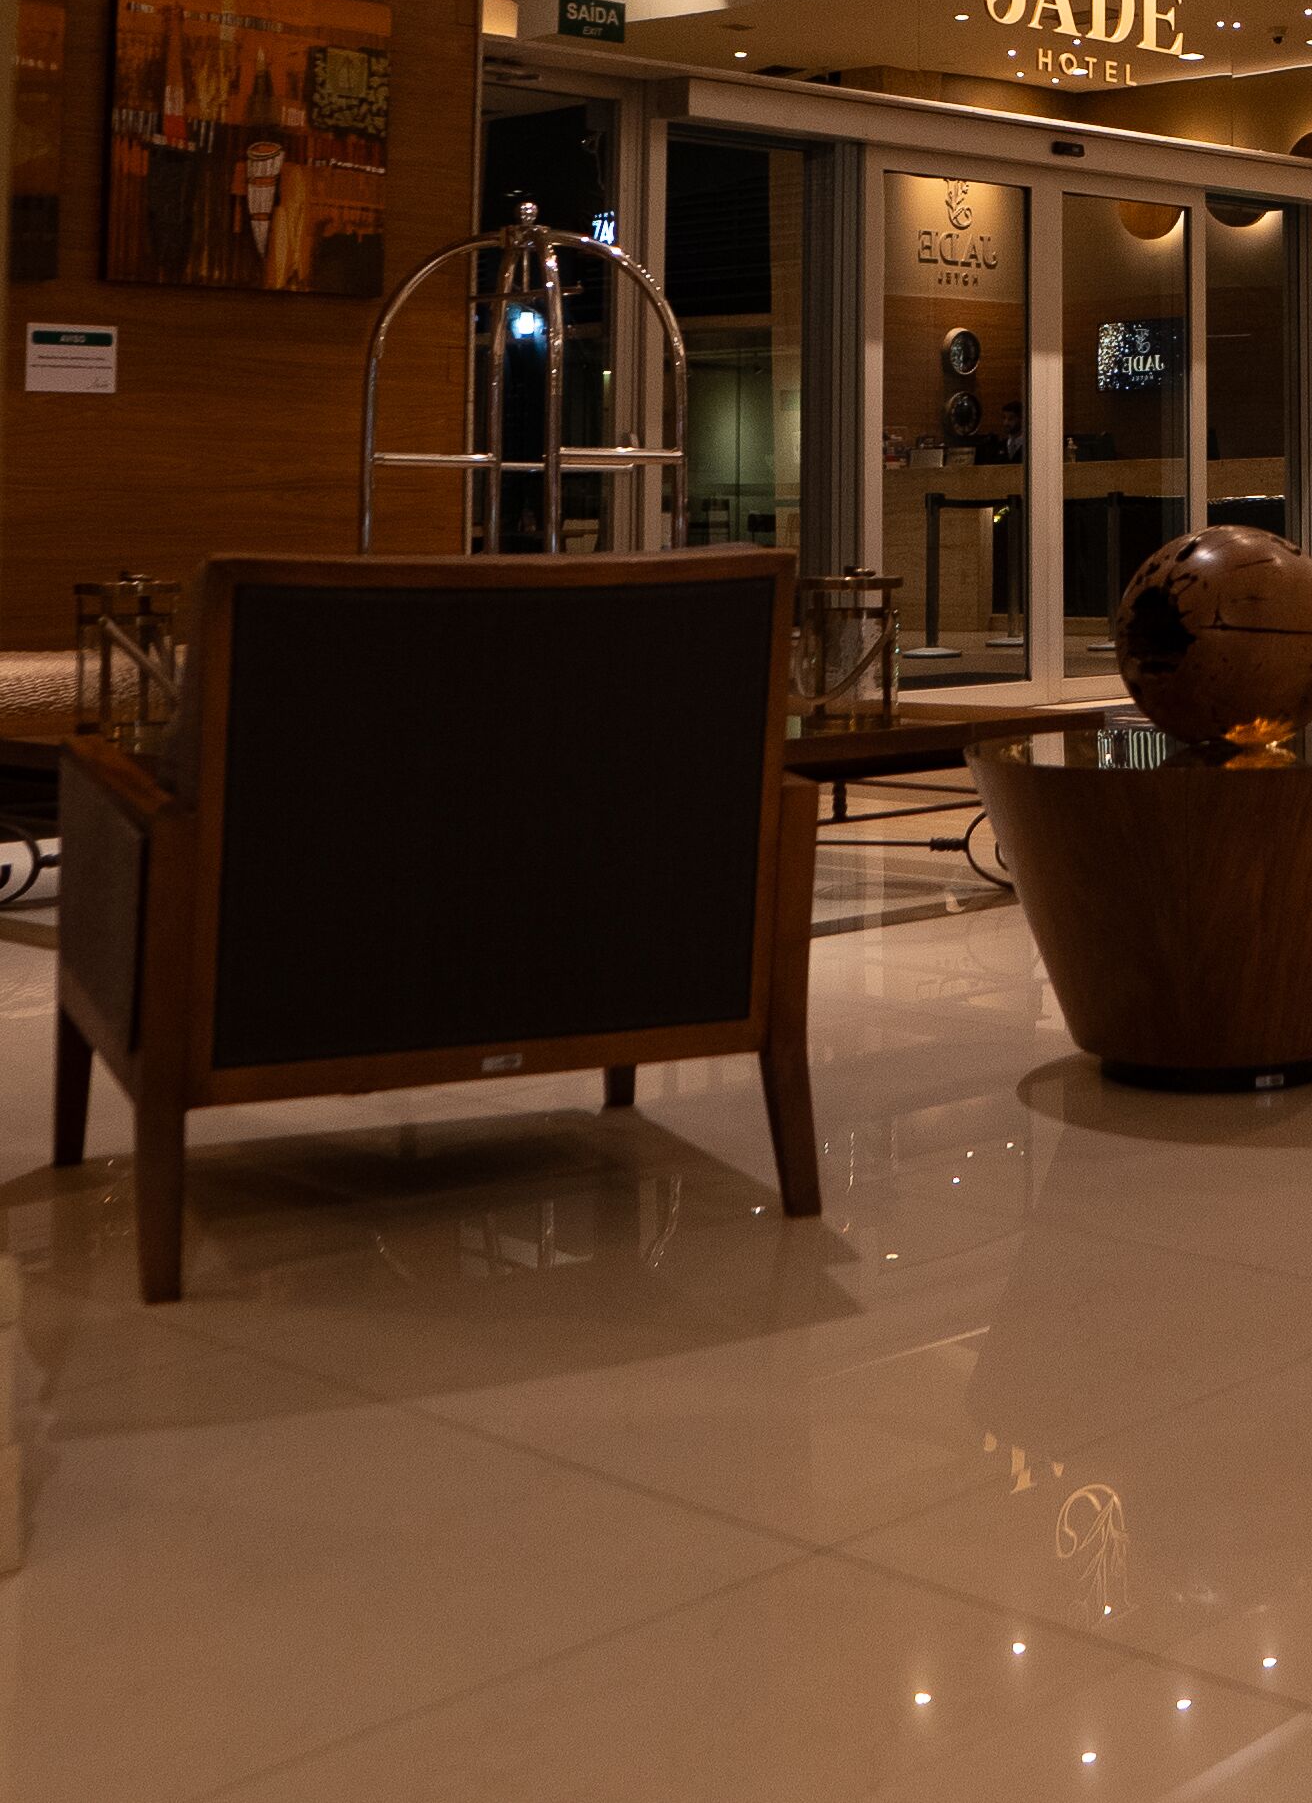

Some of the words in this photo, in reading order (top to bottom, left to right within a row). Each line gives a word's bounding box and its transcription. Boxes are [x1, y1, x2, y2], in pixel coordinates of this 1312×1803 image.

[566, 1, 619, 26] SAÍDA
[583, 25, 604, 36] EXIT
[1038, 48, 1138, 86] HOTEL
